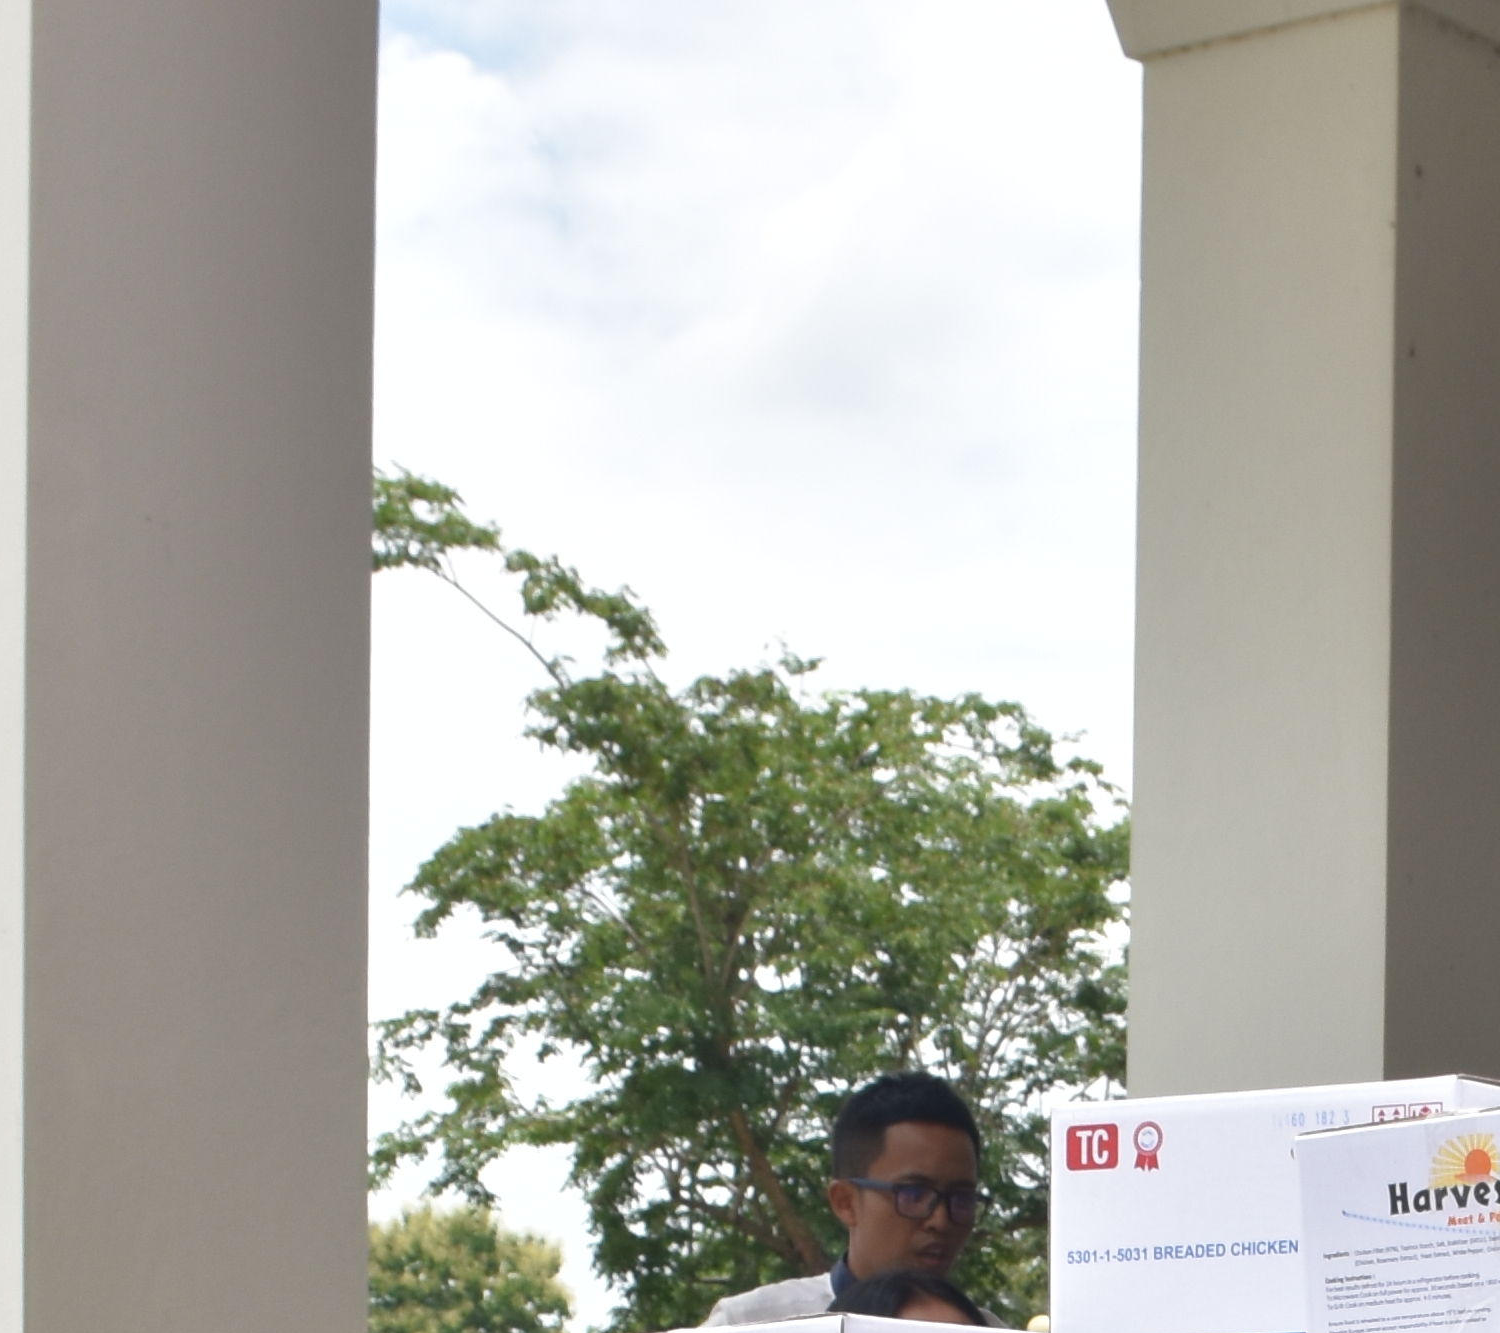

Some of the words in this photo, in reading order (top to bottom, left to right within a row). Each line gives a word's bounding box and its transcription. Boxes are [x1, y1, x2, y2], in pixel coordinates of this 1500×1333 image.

[1076, 1130, 1109, 1166] TC
[1448, 1215, 1474, 1226] Meat
[1067, 1247, 1147, 1264] 5301-1-5031
[1153, 1243, 1226, 1260] BREADED
[1230, 1240, 1298, 1256] CHICKEN
